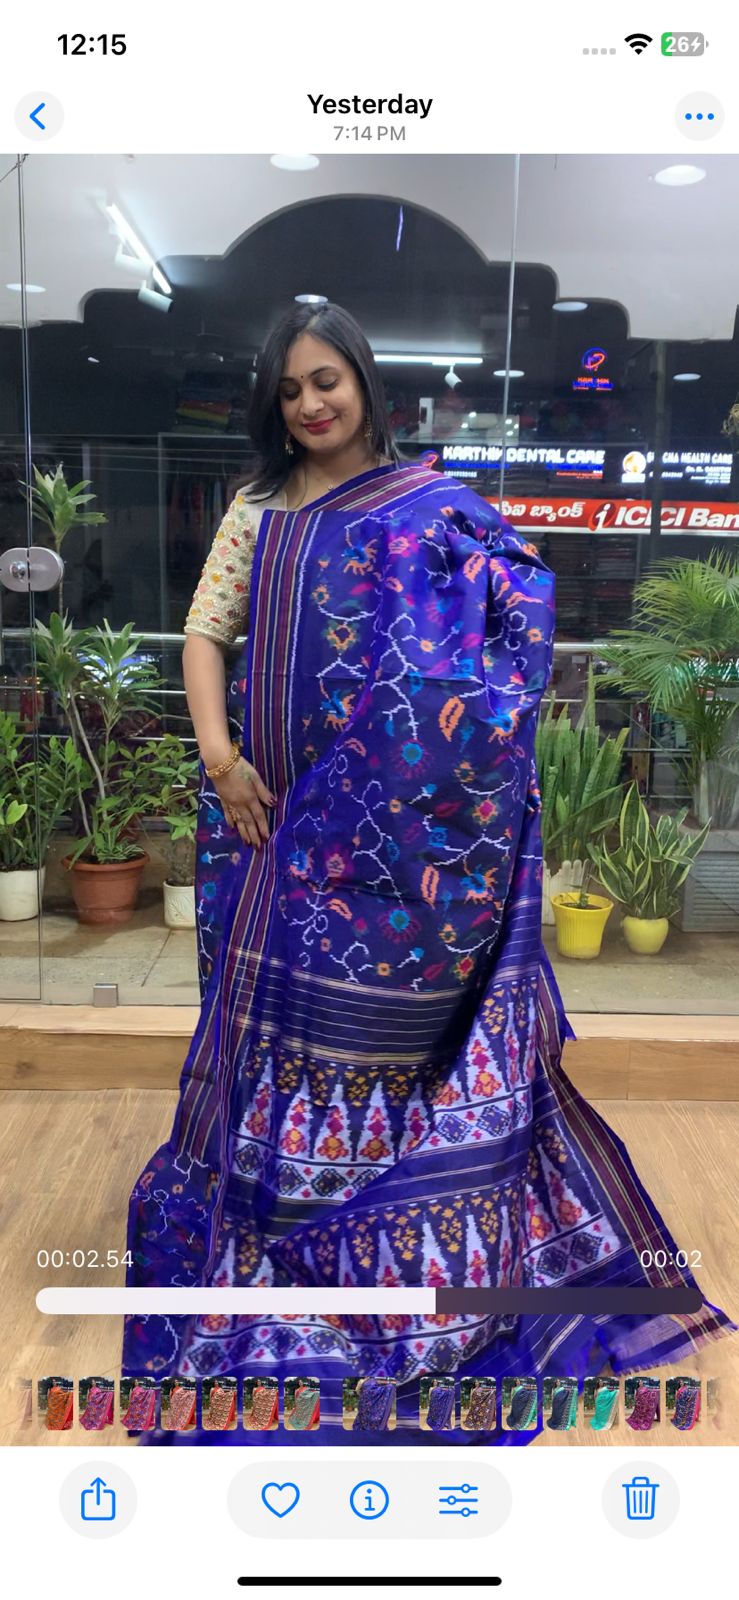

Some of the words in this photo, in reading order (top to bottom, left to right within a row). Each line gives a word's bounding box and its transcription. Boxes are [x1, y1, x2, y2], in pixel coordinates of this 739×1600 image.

[506, 447, 565, 463] DENTAL
[566, 449, 606, 464] CARE
[680, 452, 711, 464] HEALTH
[711, 453, 733, 465] CARE
